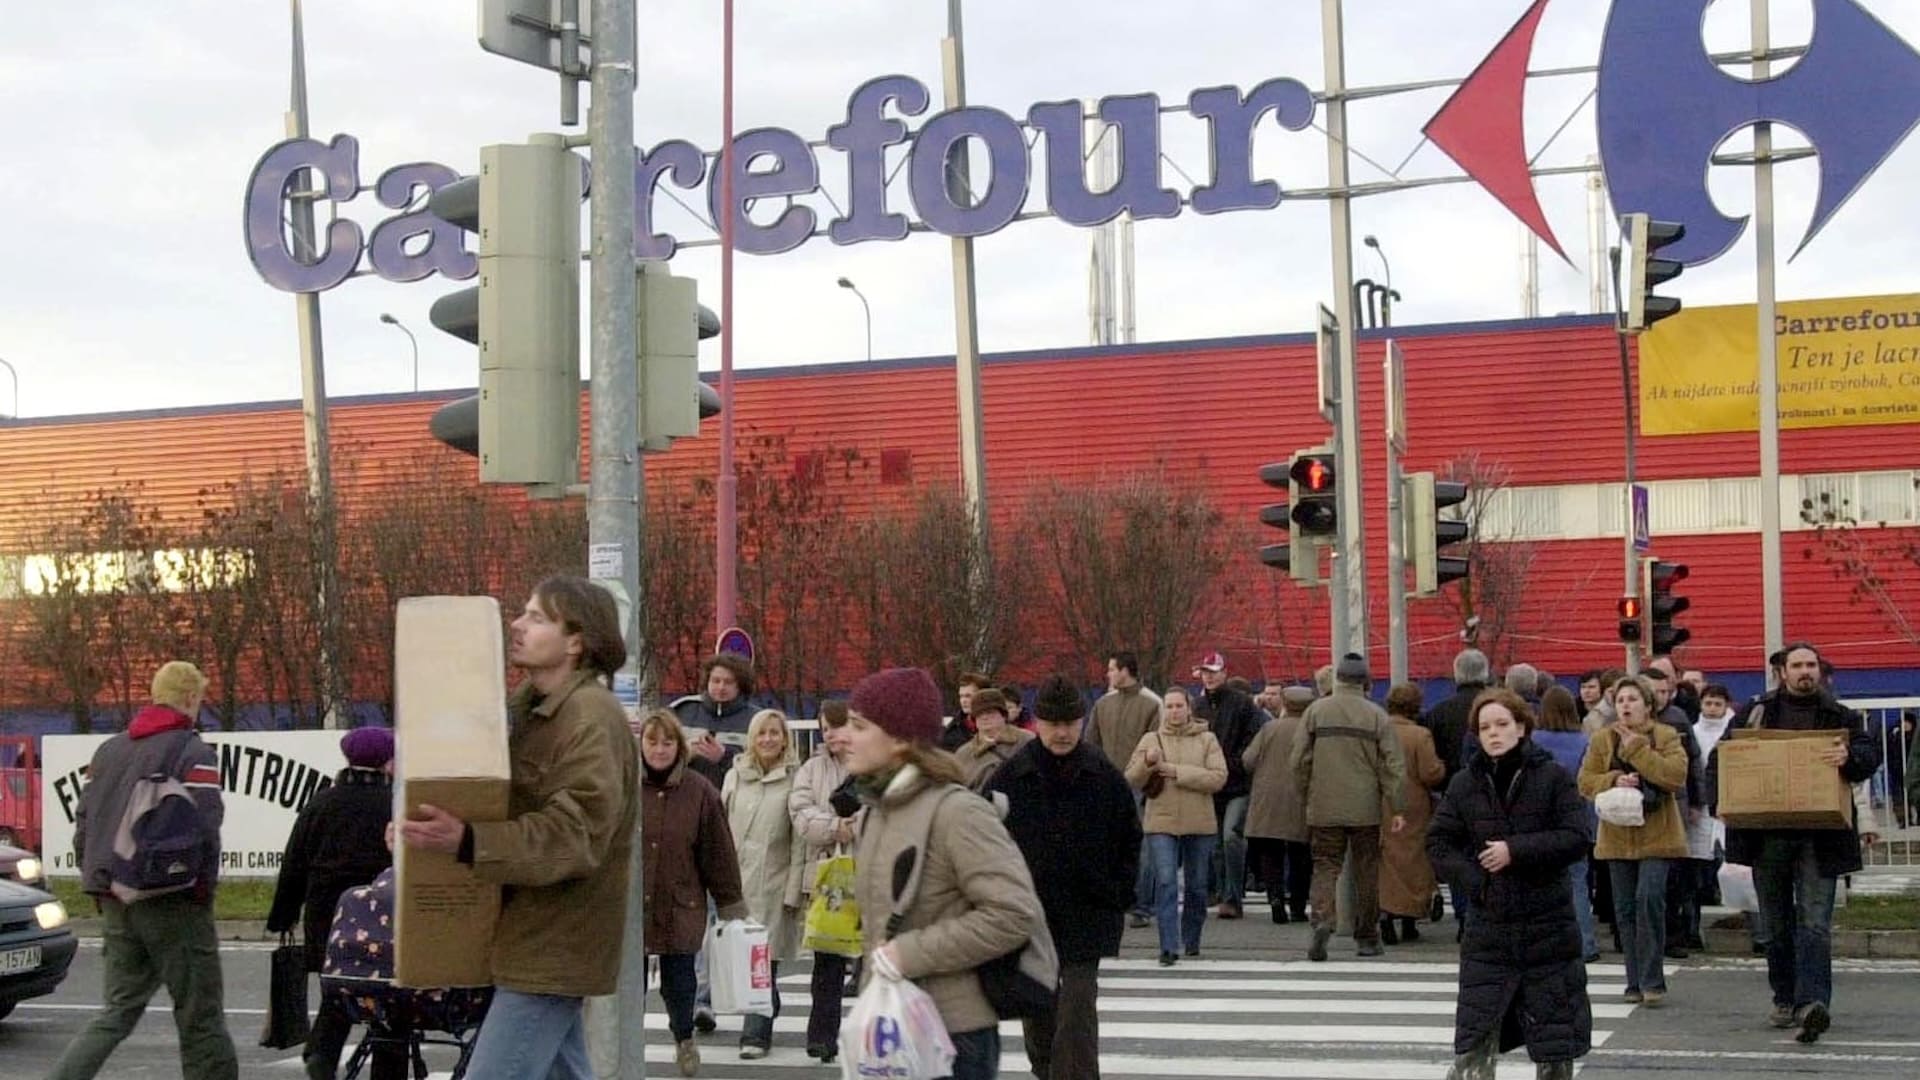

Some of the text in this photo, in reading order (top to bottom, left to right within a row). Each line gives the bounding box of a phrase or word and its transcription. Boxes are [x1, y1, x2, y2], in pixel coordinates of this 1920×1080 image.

[243, 75, 1316, 293] Carefour
[1788, 345, 1834, 369] Ten
[1840, 342, 1865, 372] je
[1646, 386, 1668, 400] Ak
[221, 851, 242, 869] PRI
